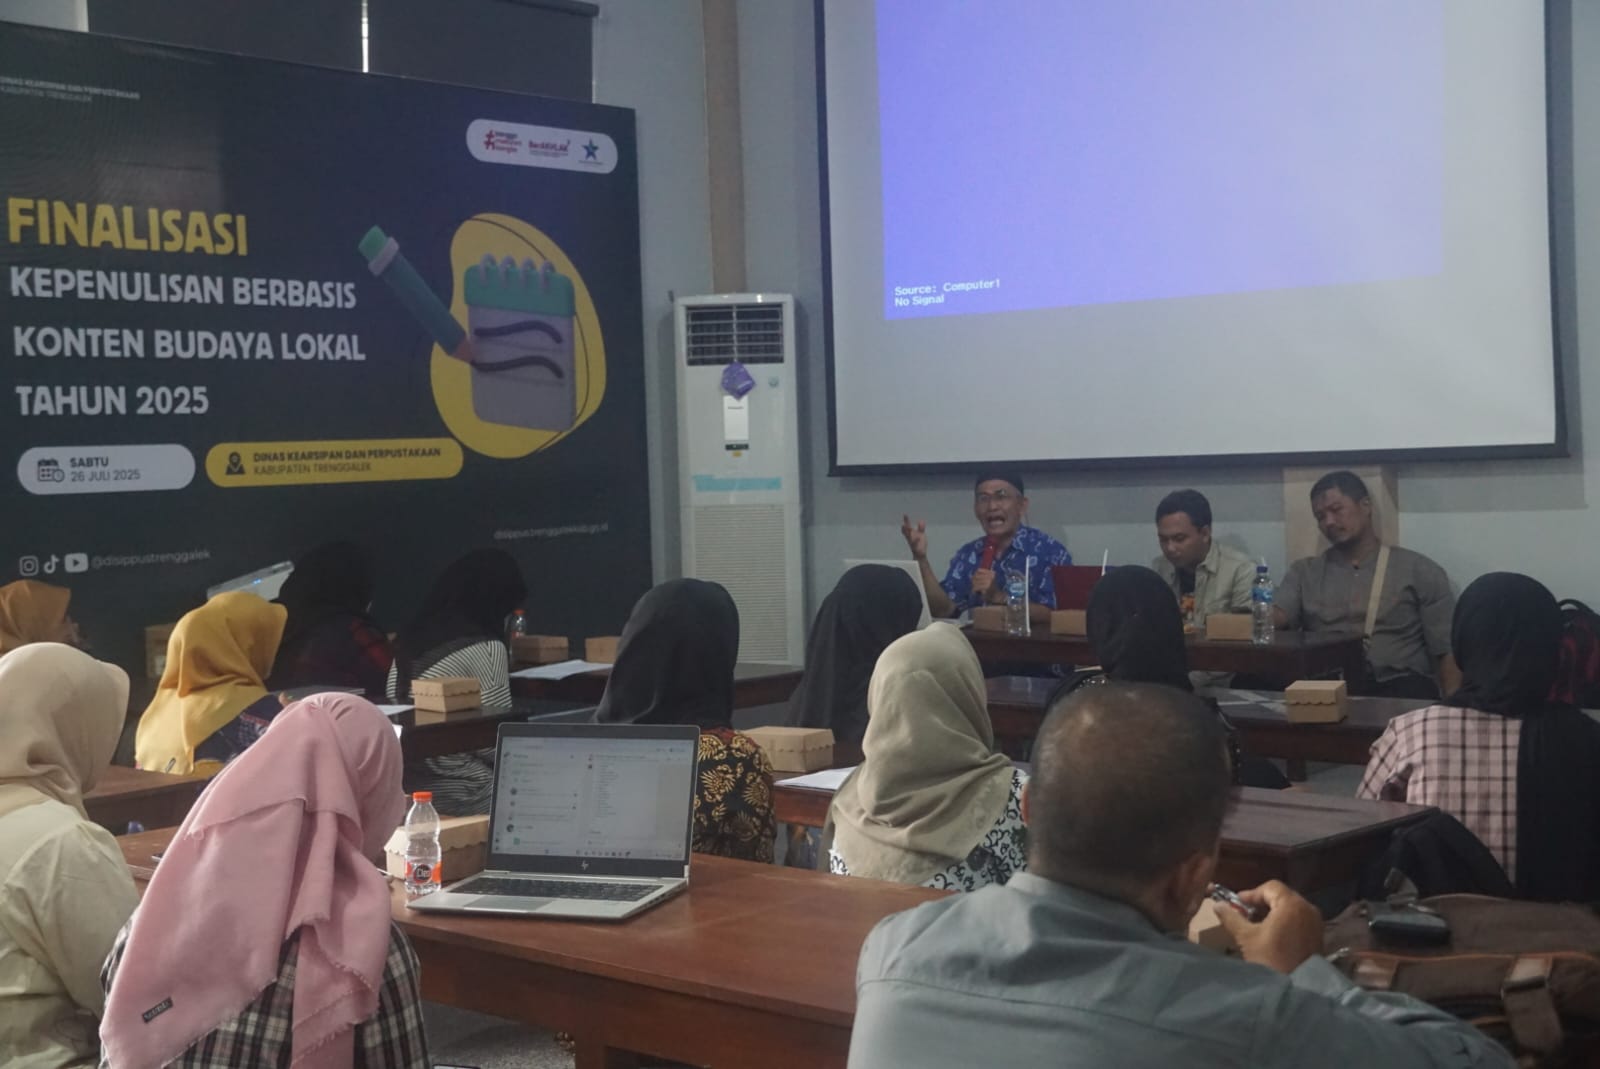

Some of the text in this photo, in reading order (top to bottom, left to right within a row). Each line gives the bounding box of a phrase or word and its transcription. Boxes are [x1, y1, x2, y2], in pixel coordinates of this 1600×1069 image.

[8, 198, 249, 256] FINALISASI
[10, 266, 358, 310] KEPENULISAN BERBASIS
[895, 279, 1000, 296] Source: Computer1
[895, 294, 945, 307] No Signal
[13, 326, 367, 361] KONTEN BUDAYA LOKAL
[16, 386, 210, 416] TAHUN 2025
[69, 457, 109, 468] SABTU
[253, 448, 442, 463] DINAS KEARSIPAN DAN PERPUSTAKAAN
[70, 469, 141, 482] 26 JULI 2025
[253, 462, 372, 475] KABUPATEN TRENGGALEK
